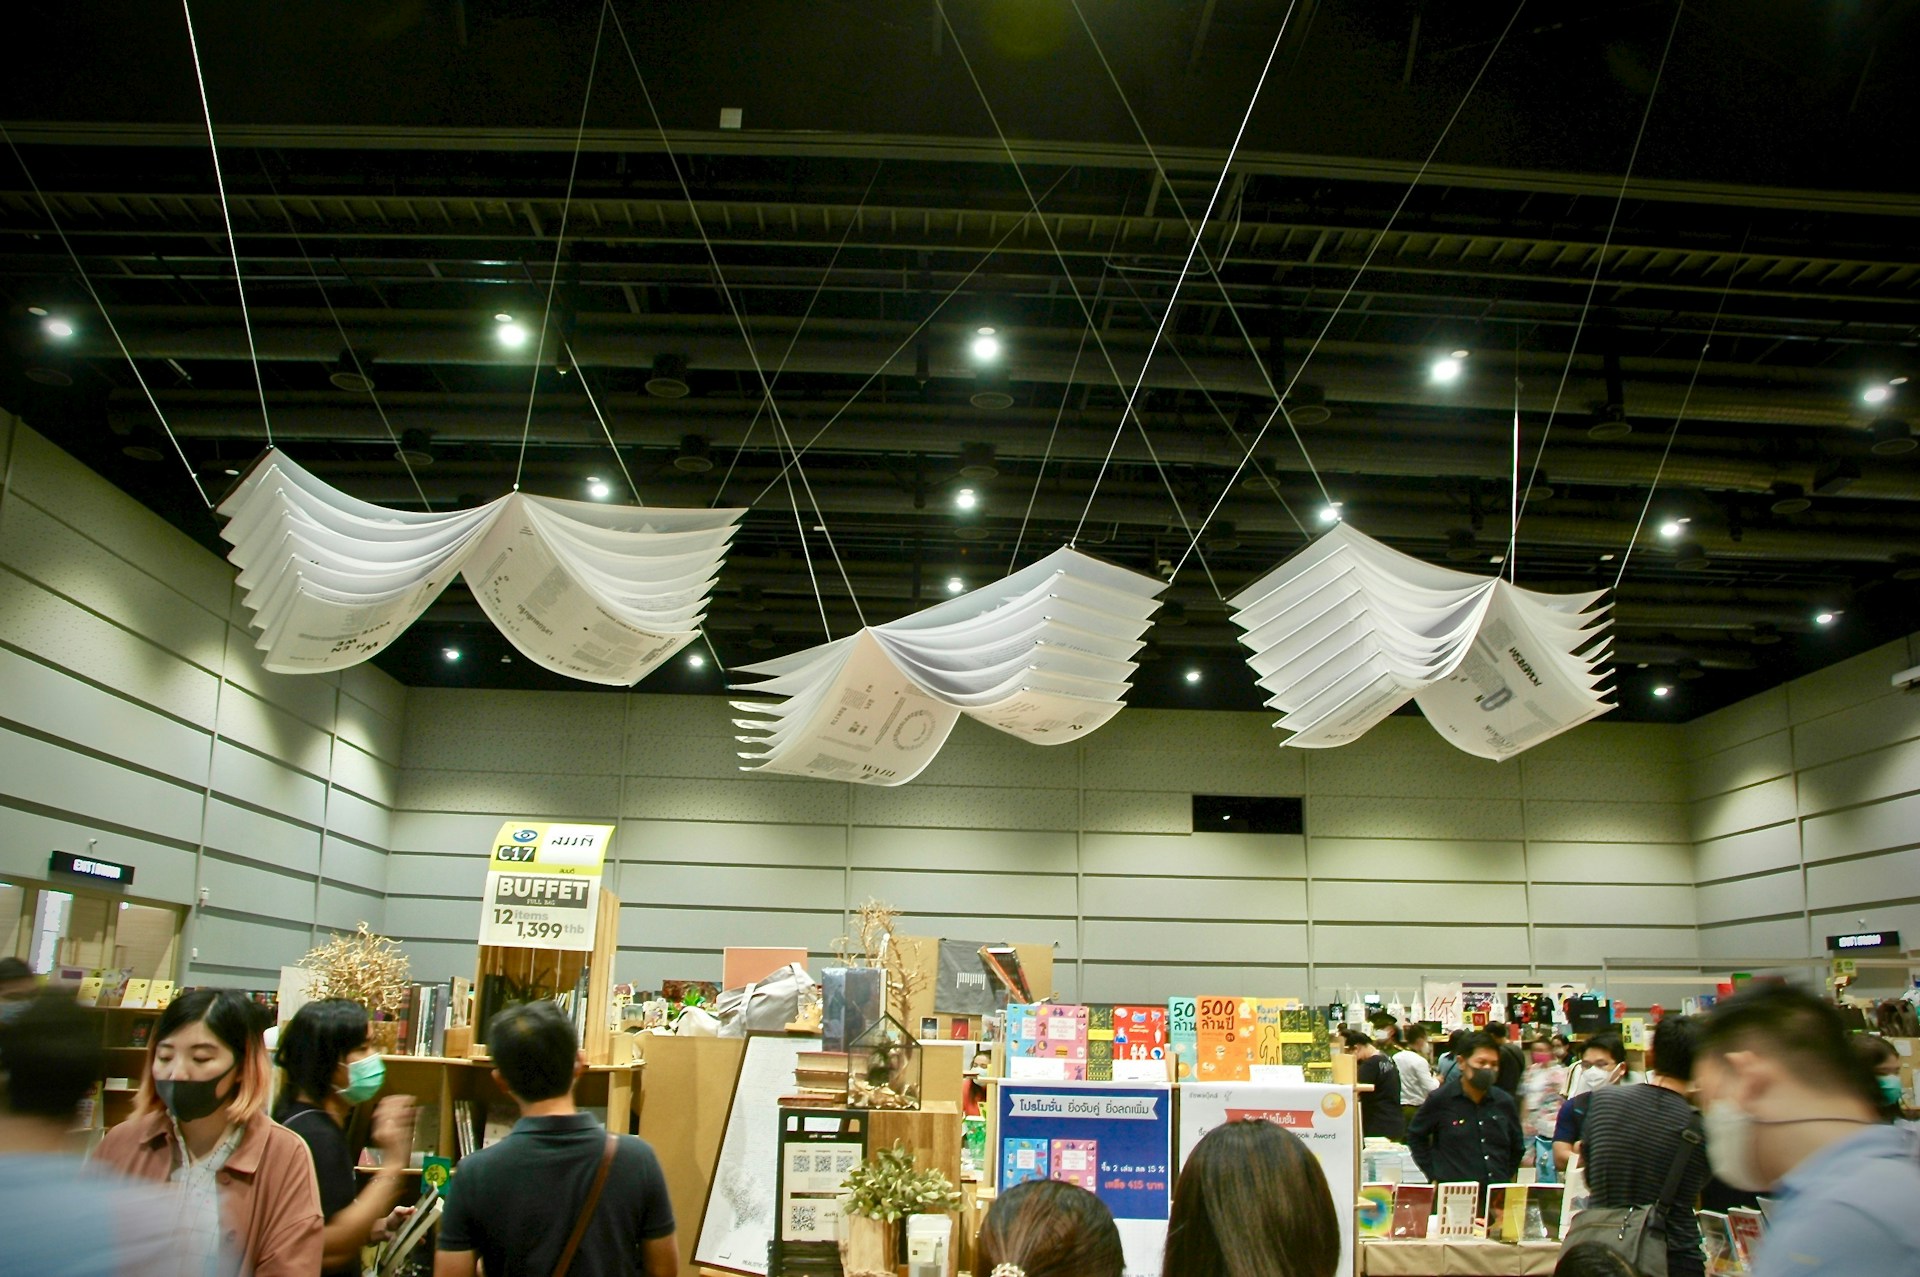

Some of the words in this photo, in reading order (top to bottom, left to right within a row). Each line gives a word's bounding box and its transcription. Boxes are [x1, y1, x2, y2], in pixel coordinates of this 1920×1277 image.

[498, 846, 534, 861] C17
[497, 877, 589, 901] BUFFET
[494, 908, 514, 925] 12
[514, 910, 549, 921] items
[517, 921, 563, 939] 1,399
[564, 924, 585, 935] thb
[1174, 1002, 1196, 1018] 50
[1201, 1000, 1235, 1016] 500
[1202, 1016, 1235, 1031] ล้านปี
[1019, 1098, 1062, 1112] โปรโมชั่น
[1067, 1100, 1100, 1116] ยิ่งจับคู่
[1105, 1100, 1149, 1115] ยิ่งลดเพิ่ม
[1313, 1132, 1336, 1140] Award
[1112, 1164, 1118, 1172] 2
[1148, 1165, 1157, 1173] 15
